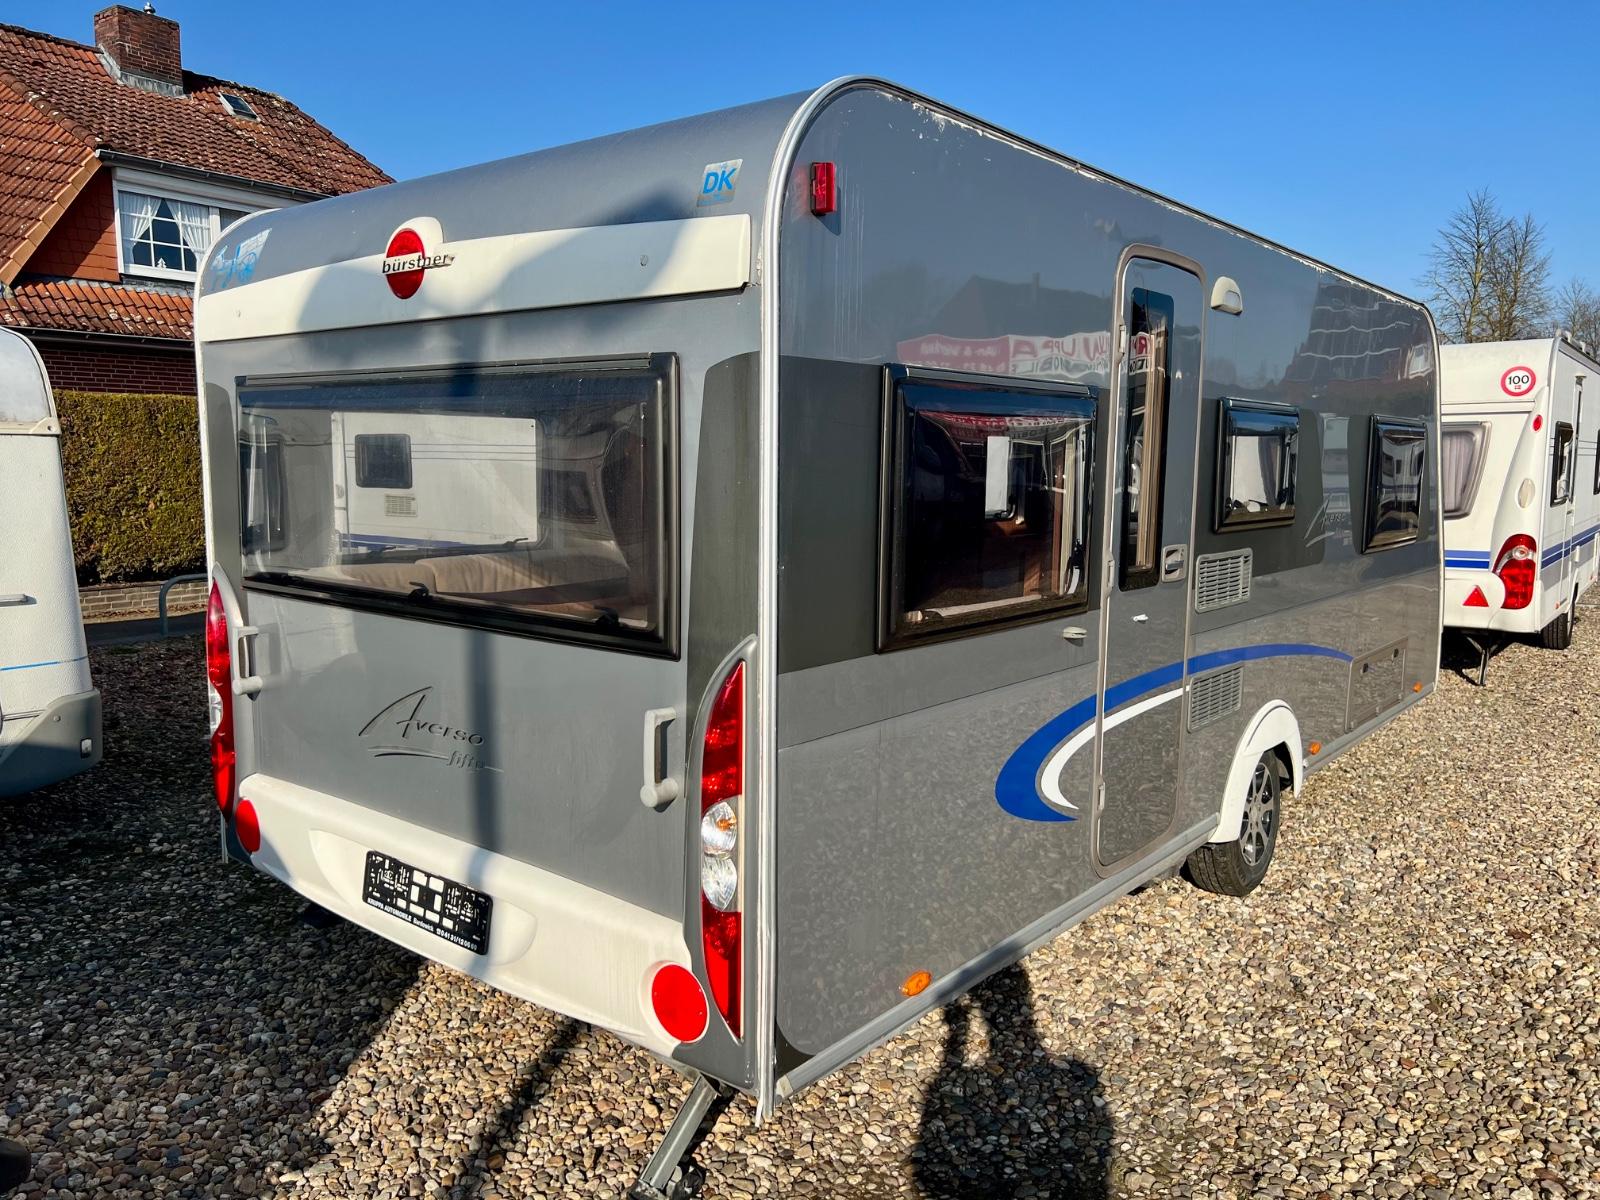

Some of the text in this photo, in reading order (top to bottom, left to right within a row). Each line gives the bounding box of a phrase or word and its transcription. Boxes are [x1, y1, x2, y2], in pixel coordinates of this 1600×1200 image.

[702, 167, 737, 194] DK
[382, 253, 449, 274] bürstner
[1508, 375, 1530, 385] 100
[358, 686, 483, 746] Averso
